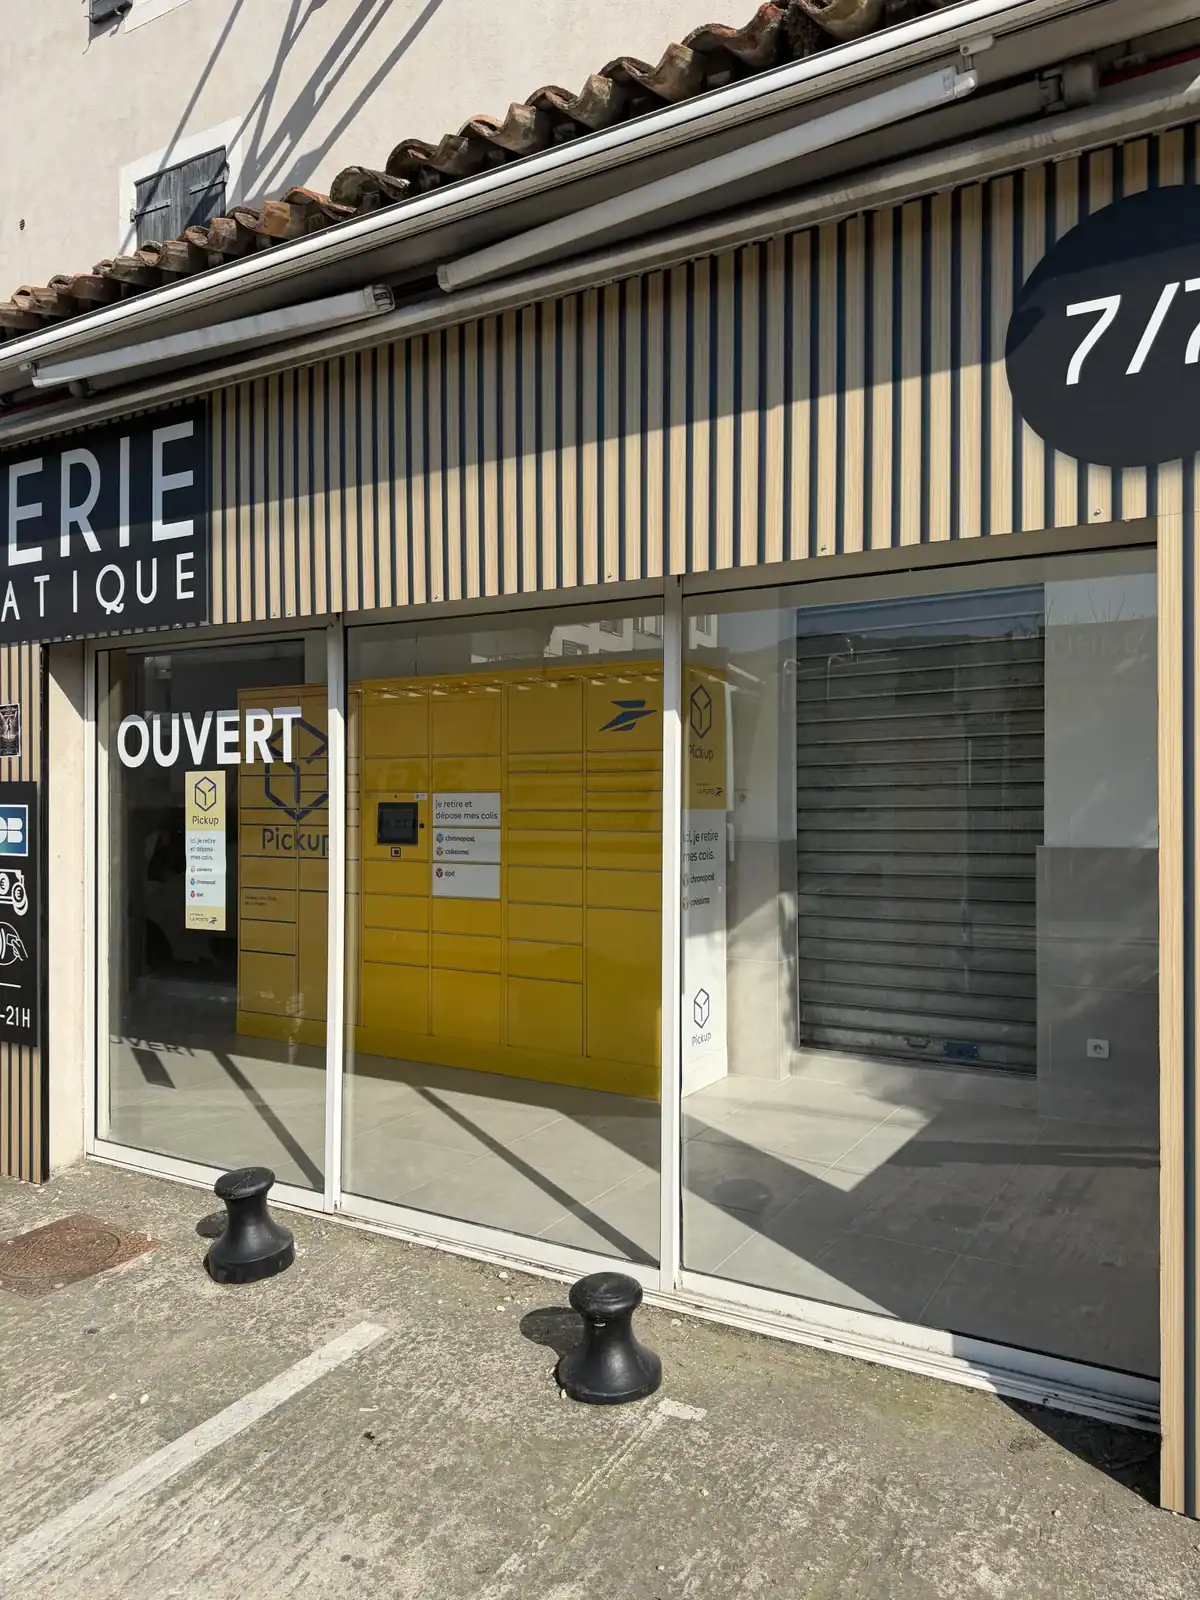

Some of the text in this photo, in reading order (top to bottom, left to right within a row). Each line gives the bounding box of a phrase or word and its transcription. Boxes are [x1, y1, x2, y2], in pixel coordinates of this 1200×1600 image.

[1066, 276, 1200, 386] 7/
[8, 420, 194, 567] ERIE
[1, 552, 195, 623] ATIQUE
[117, 706, 302, 768] OUVERT
[435, 800, 442, 809] je
[443, 800, 463, 808] retire
[192, 815, 219, 827] Pickup
[435, 811, 462, 820] dépose
[480, 811, 498, 820] colis
[444, 834, 475, 843] chronopost
[692, 829, 700, 845] je
[700, 829, 719, 841] retire
[682, 848, 715, 861] mes colis.
[444, 869, 455, 877] dpd
[690, 872, 715, 885] chronopost
[690, 896, 711, 908] colissimo
[691, 1032, 712, 1047] Pickup
